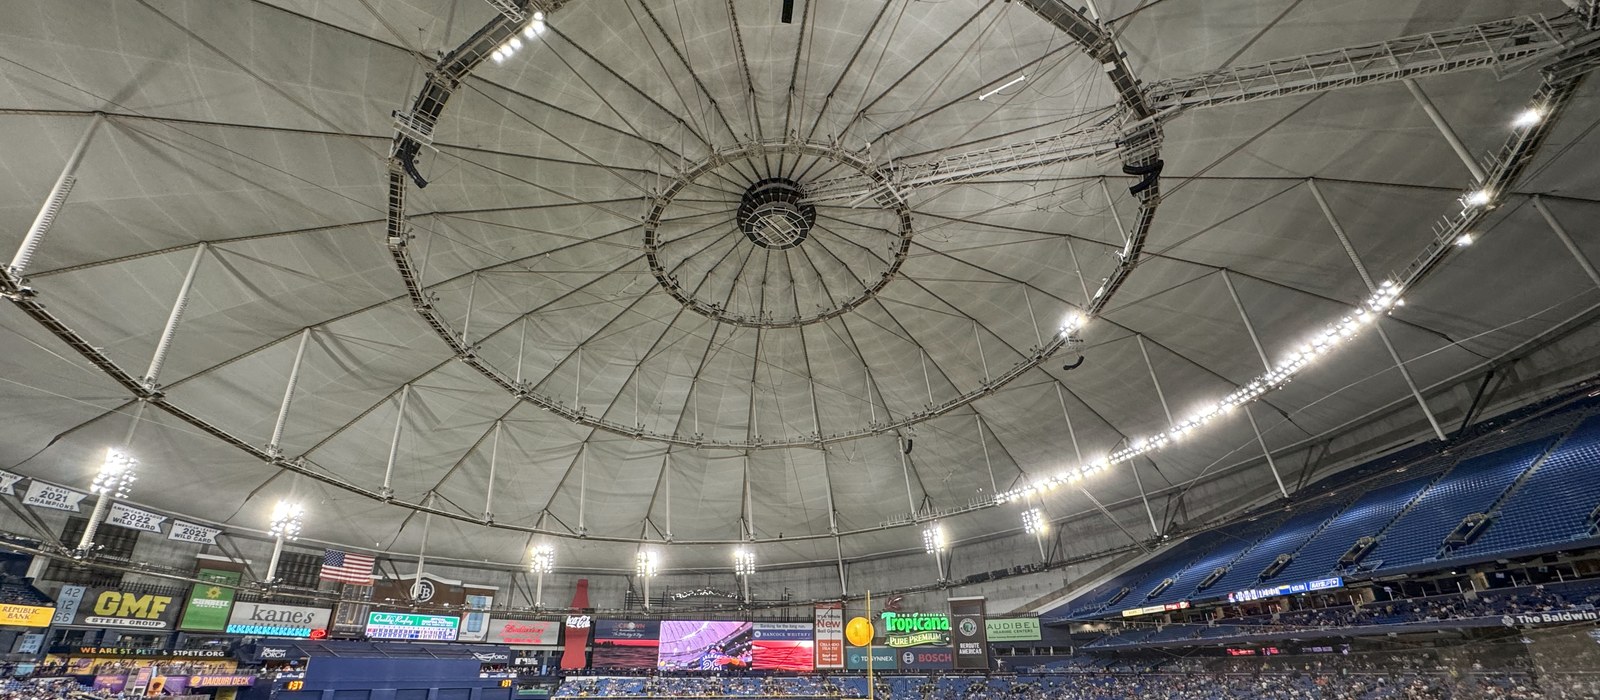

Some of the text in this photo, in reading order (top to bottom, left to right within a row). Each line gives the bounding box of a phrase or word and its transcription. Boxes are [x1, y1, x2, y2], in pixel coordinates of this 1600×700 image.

[40, 490, 68, 502] 2021
[28, 496, 74, 510] CHAMPIONS
[114, 506, 141, 515] AMERICAN
[112, 516, 155, 530] WILD CARD
[122, 512, 150, 524] 2022
[175, 522, 198, 530] AMERICAN
[183, 528, 207, 538] 2023
[65, 588, 80, 597] 42
[62, 600, 74, 609] 12
[94, 591, 172, 619] GMF
[2, 606, 40, 614] REPUBLIC
[249, 605, 314, 624] kanes
[55, 613, 70, 622] 66
[1516, 610, 1598, 624] The Baldwin
[817, 619, 840, 628] New
[881, 612, 949, 633] Tropicana
[890, 634, 942, 645] PURE PREMIUM
[918, 654, 952, 662] BOSCH
[202, 677, 250, 685] DAIQUIRI DECK
